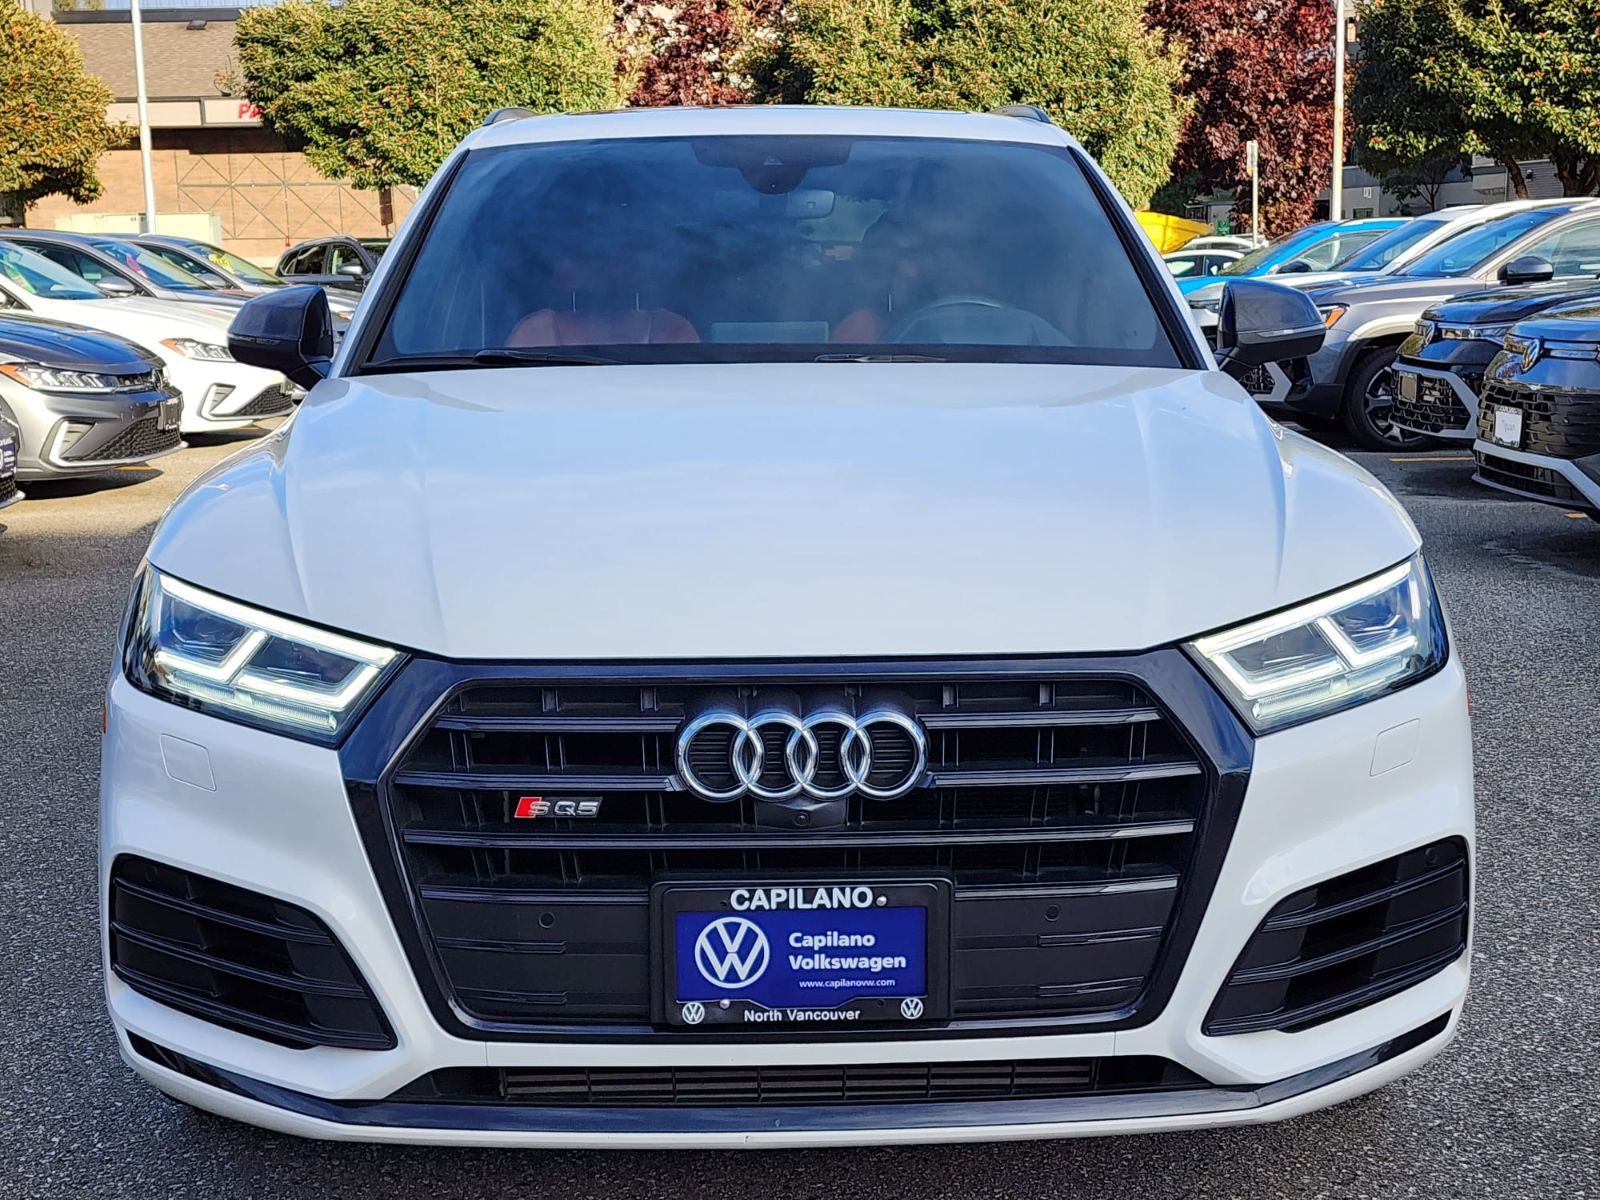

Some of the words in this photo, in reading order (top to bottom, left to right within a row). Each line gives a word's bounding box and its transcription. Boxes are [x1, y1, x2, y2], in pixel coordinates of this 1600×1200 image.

[528, 801, 599, 816] SQ5
[730, 887, 874, 911] CAPILANO
[788, 931, 876, 950] Capilano
[789, 954, 906, 972] Volkswagen
[799, 978, 896, 988] www.capilanovw.com
[744, 1009, 782, 1022] North
[787, 1009, 860, 1022] Vancouver
